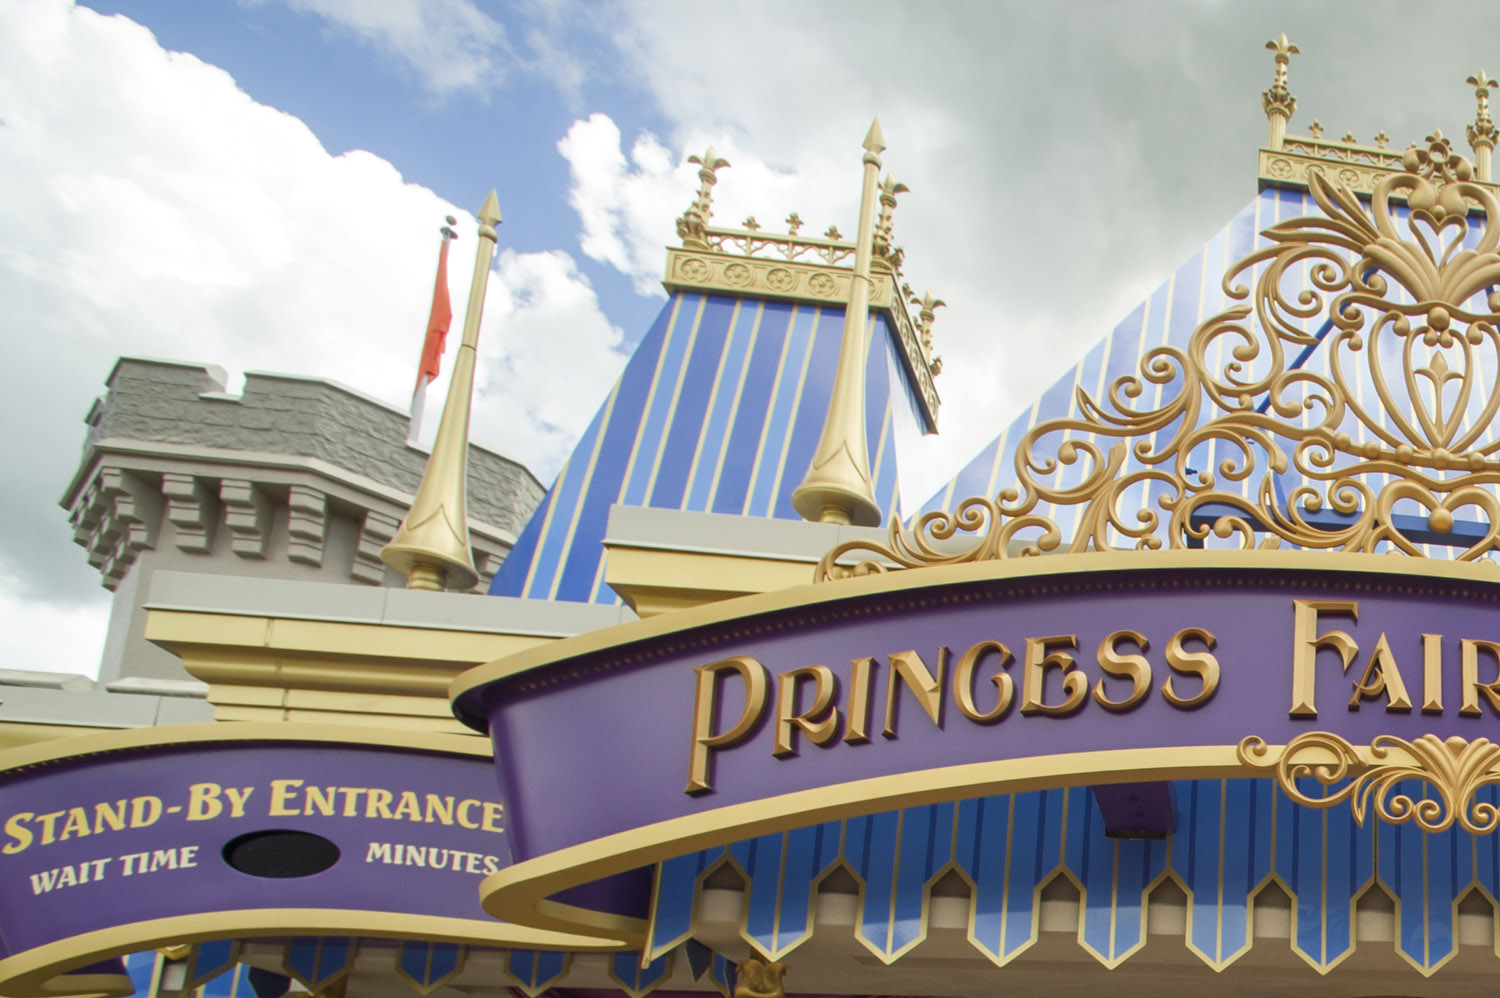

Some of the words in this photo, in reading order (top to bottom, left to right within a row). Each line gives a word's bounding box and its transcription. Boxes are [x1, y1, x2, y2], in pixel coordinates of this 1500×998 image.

[683, 627, 1221, 798] PRINCESS
[2, 782, 255, 856] STAND-BY
[269, 779, 504, 834] ENTRANCE
[29, 857, 112, 896] WAIT
[119, 845, 199, 875] TIME
[365, 841, 500, 876] MINUTES
